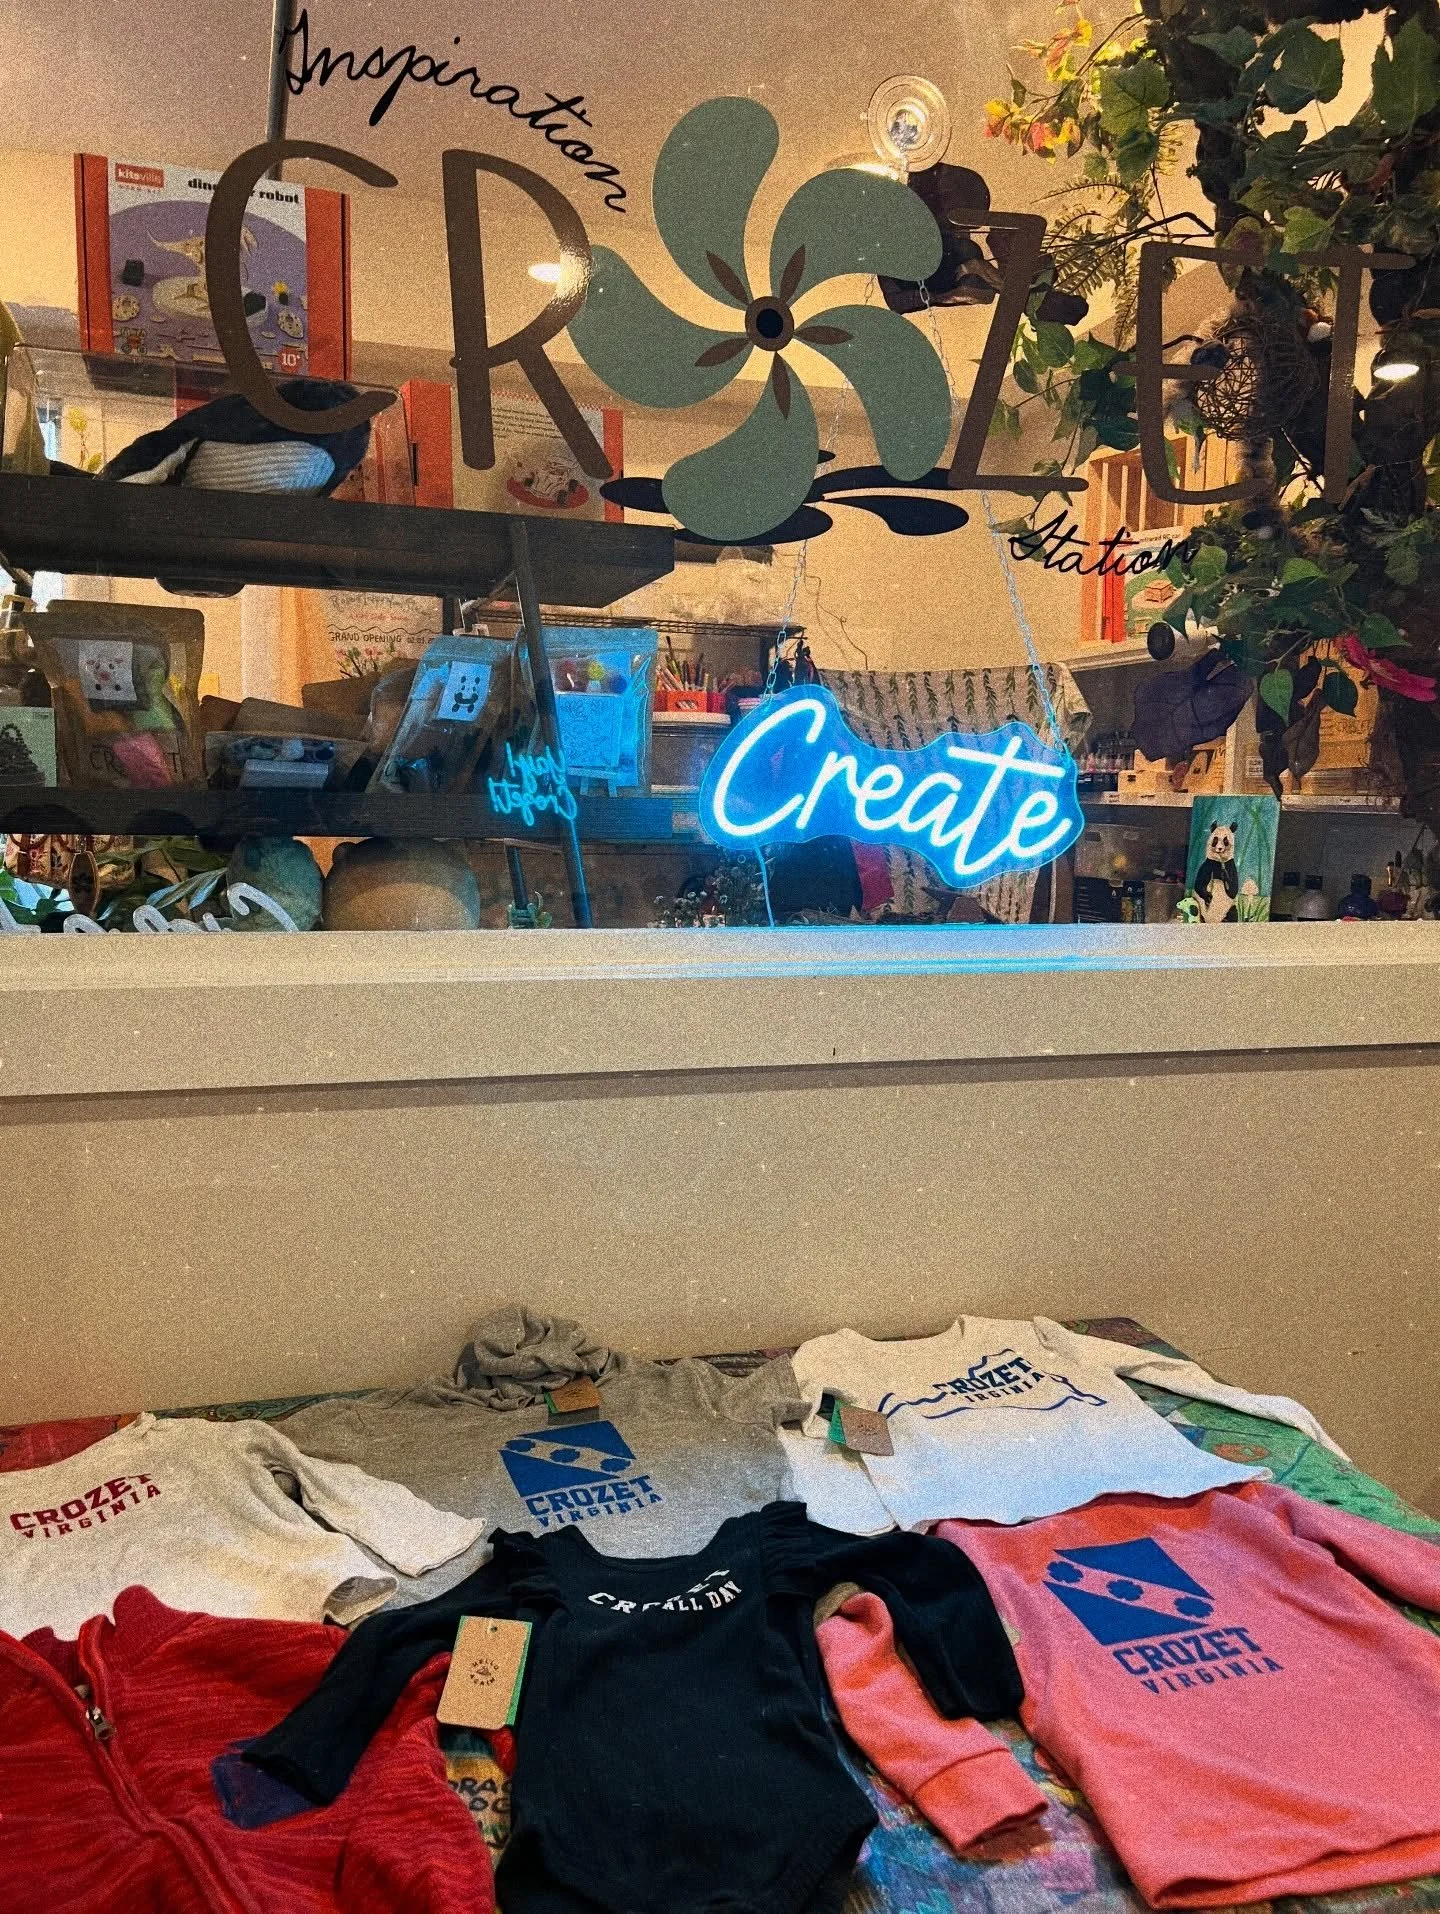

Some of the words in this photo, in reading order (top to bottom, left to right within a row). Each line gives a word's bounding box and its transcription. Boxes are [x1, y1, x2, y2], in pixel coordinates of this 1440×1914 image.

[279, 9, 628, 214] Inspiration
[259, 190, 299, 204] robot
[1008, 509, 1200, 577] Station
[328, 631, 360, 643] GRAND
[363, 634, 402, 644] OPENING
[89, 743, 181, 779] CRT
[712, 697, 1074, 876] Create
[964, 1371, 1046, 1403] IRGINIA
[9, 1473, 153, 1531] CROZET
[21, 1484, 162, 1539] VIRGINIA
[525, 1475, 653, 1516] CROZET
[536, 1493, 663, 1528] VIRGINIA
[661, 1596, 704, 1612] ALL
[705, 1580, 743, 1609] DAY
[1112, 1626, 1263, 1676] CROZET
[1139, 1656, 1285, 1695] VIRGINIA
